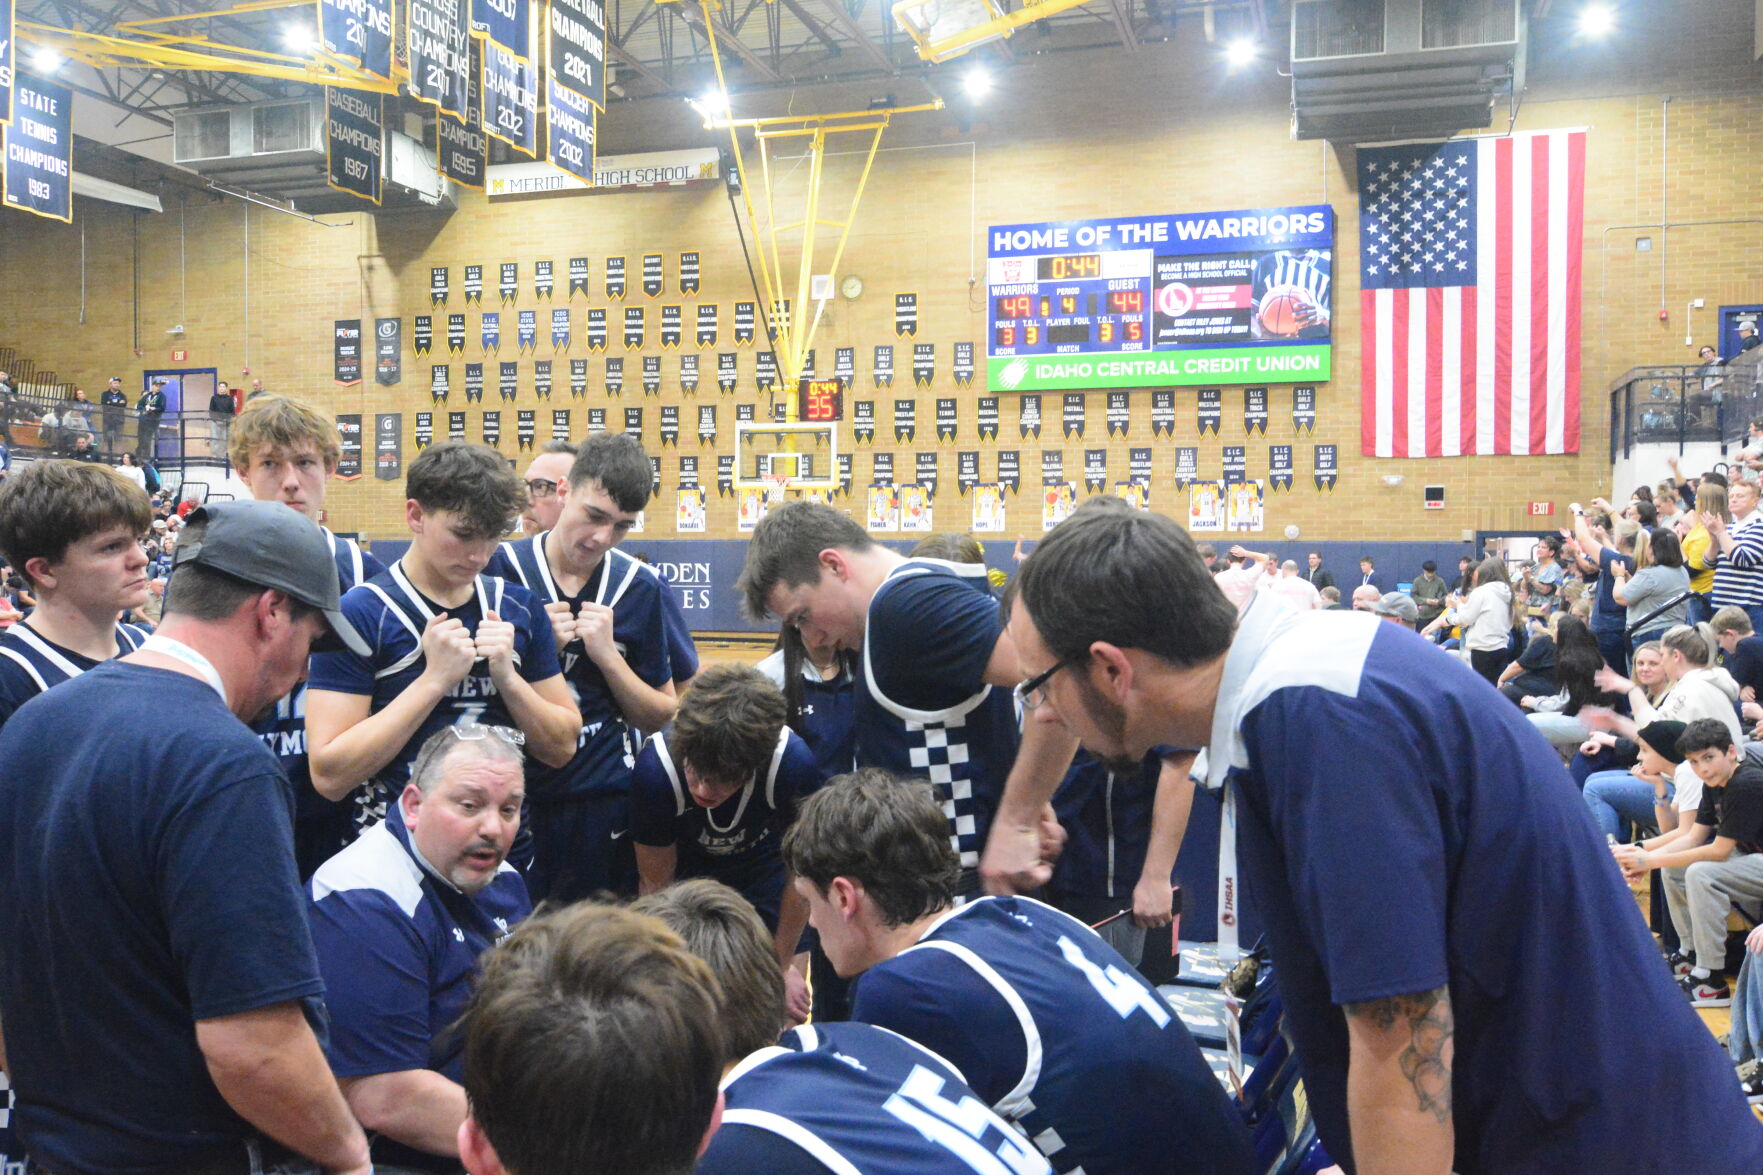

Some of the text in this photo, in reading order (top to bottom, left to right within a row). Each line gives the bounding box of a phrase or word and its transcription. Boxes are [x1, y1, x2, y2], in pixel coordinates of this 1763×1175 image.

[20, 87, 57, 116] STATE
[330, 87, 381, 127] BASEBALL
[20, 116, 57, 145] TENNIS
[9, 143, 67, 176] CHAMPIONS
[559, 138, 583, 168] 2002
[344, 156, 368, 180] 1987
[452, 151, 476, 176] 1995
[595, 170, 630, 185] HIGH
[635, 166, 694, 182] SCHOOL
[28, 178, 50, 199] 1983
[994, 213, 1324, 251] HOME OF THE WARRIORS
[1052, 255, 1099, 279] 0:44
[1158, 260, 1250, 272] MAKE THE RIGHT CALL
[1202, 270, 1223, 278] SCHOOL
[992, 284, 1038, 295] WARRIORS
[1108, 279, 1140, 290] GUEST
[1004, 297, 1030, 317] 49
[1063, 297, 1074, 313] 4
[1114, 292, 1141, 312] 44
[1004, 329, 1013, 344] 3
[1026, 327, 1037, 344] 3
[1101, 324, 1111, 341] 3
[1130, 323, 1139, 340] 5
[174, 352, 184, 360] EXIT
[1035, 355, 1320, 379] IDAHO CENTRAL CREDIT UNION
[810, 382, 837, 395] 0:44
[808, 396, 832, 418] 35
[1532, 502, 1549, 515] EXIT
